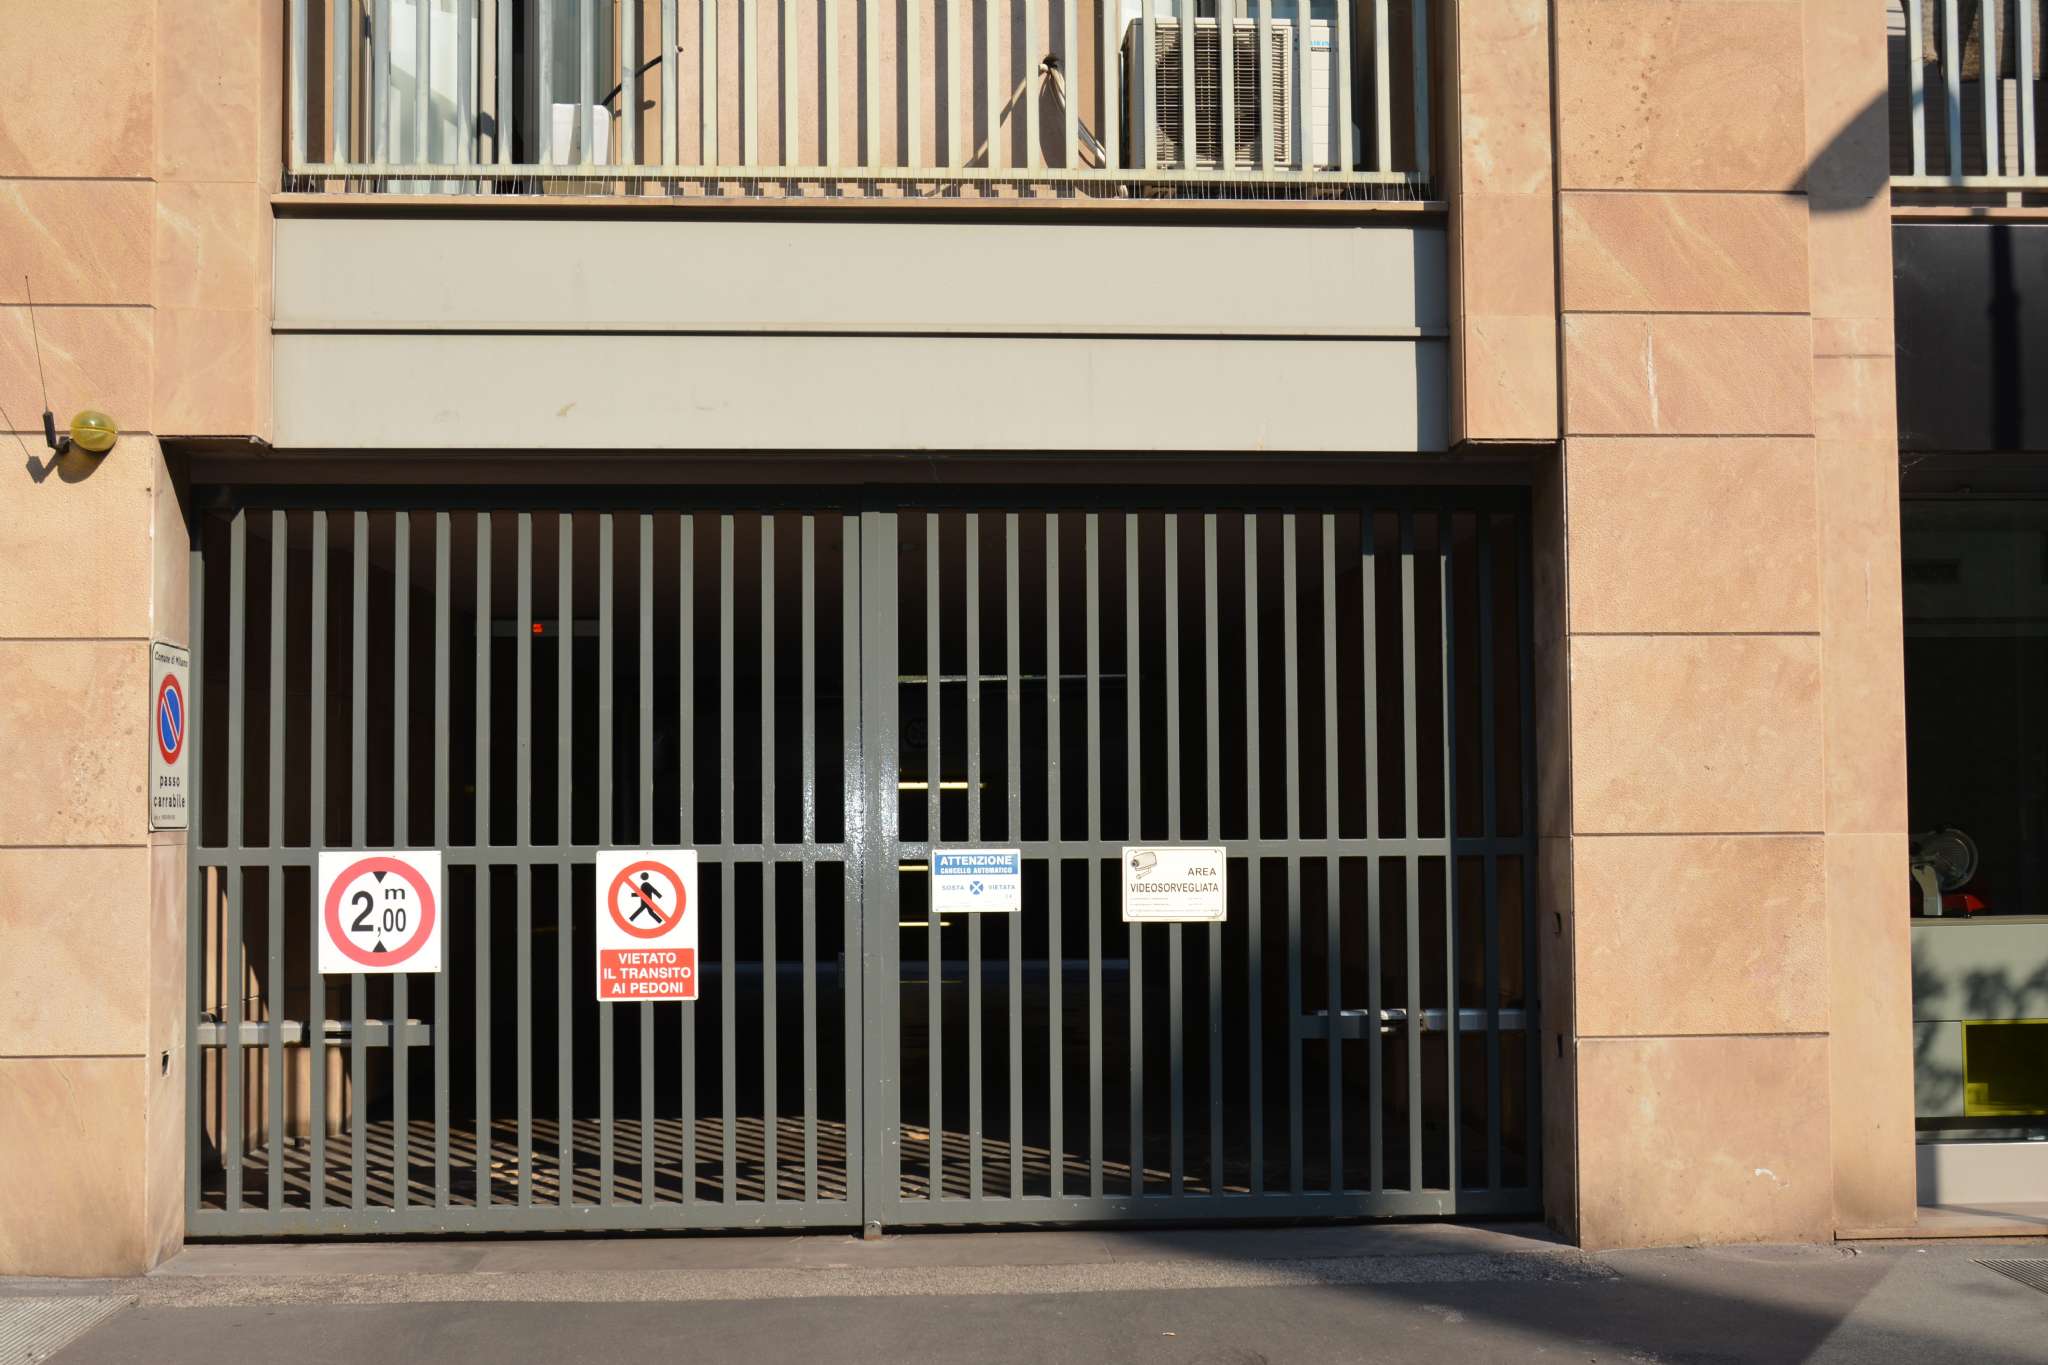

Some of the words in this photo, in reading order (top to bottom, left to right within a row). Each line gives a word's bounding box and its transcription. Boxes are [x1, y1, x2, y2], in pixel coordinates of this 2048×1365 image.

[160, 776, 180, 789] passo
[154, 793, 185, 808] carrabile
[940, 855, 1013, 866] ATTENZIONE
[1187, 867, 1217, 877] AREA
[384, 888, 406, 900] m
[1130, 883, 1219, 893] VIDEOSORVEGLIATA
[618, 952, 677, 964] VIETATO
[603, 967, 617, 979] IL
[620, 966, 692, 979] TRANSITO
[612, 982, 626, 994] AI
[630, 981, 684, 994] PEDONI
